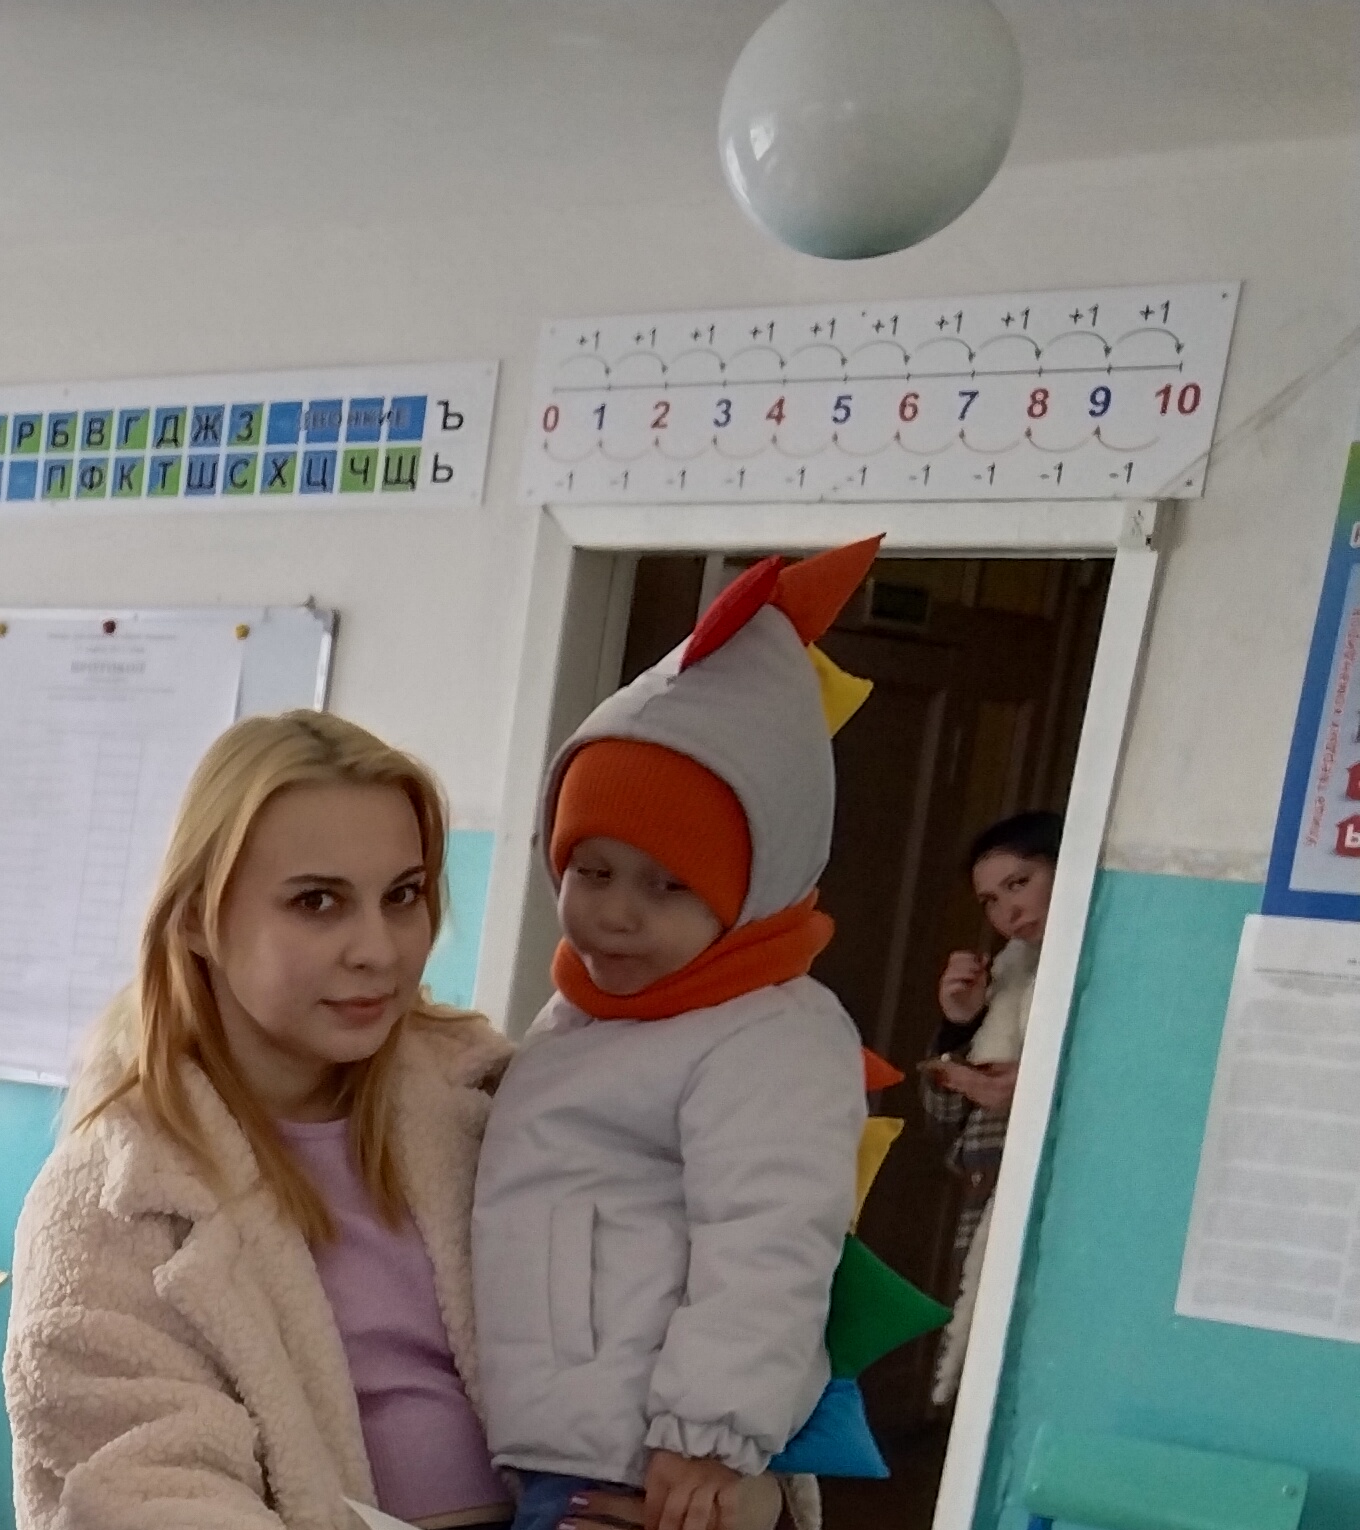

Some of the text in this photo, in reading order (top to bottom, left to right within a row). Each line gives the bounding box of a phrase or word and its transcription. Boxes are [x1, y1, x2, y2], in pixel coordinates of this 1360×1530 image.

[437, 399, 464, 431] Ъ
[542, 382, 1201, 433] 0 1 2 3 4 5 6 7 8 9 10
[17, 420, 34, 448] Р
[51, 419, 69, 448] Б
[86, 417, 104, 447] В
[124, 416, 141, 444] Г
[156, 415, 179, 449] Д
[192, 414, 220, 442] Ж
[237, 411, 253, 441] З
[47, 454, 416, 494] П Ф К Т Ш С Х Ц Ч Щ
[431, 452, 453, 483] Ь
